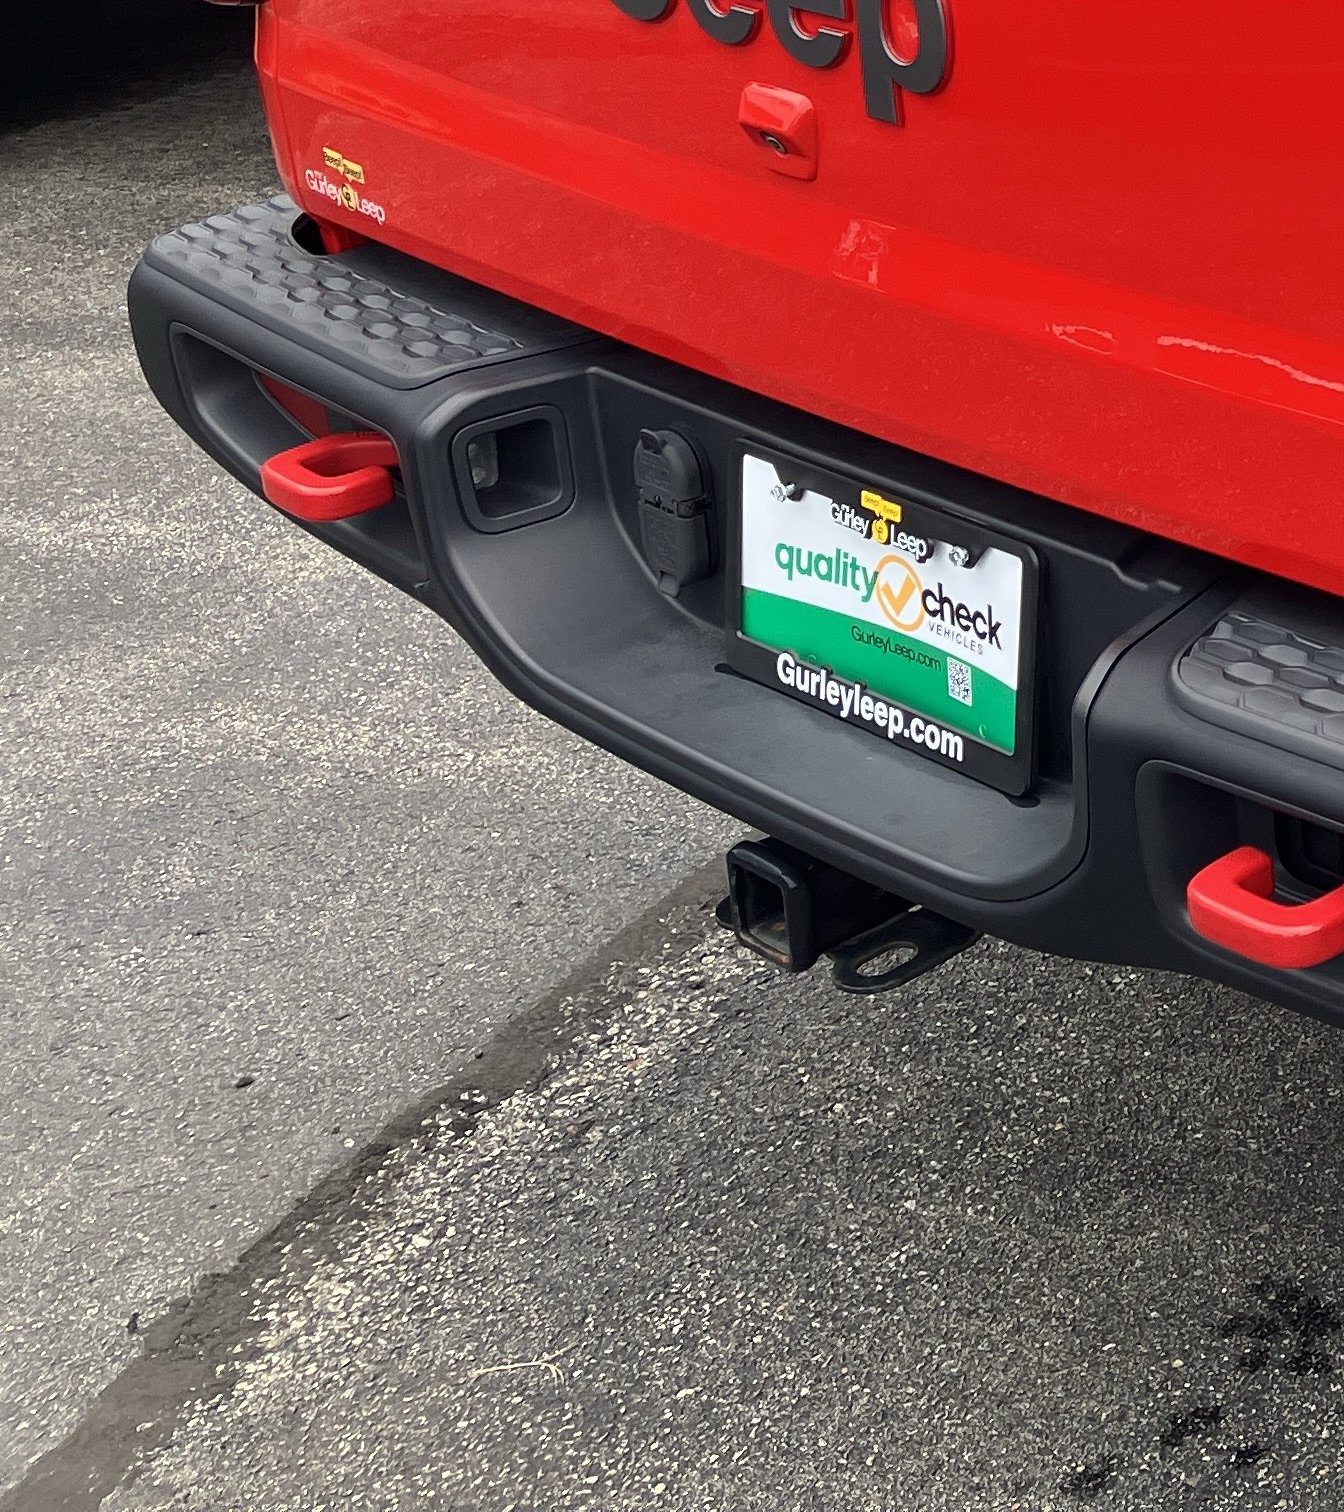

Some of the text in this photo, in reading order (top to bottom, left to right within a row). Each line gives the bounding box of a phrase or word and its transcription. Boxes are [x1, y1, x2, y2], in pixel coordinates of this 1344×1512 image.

[890, 523, 927, 561] Leep
[774, 542, 1002, 651] quality check
[850, 625, 942, 672] GurleyLeep.com
[928, 620, 984, 656] VEHICLES
[776, 652, 965, 762] Gurleyleep.com
